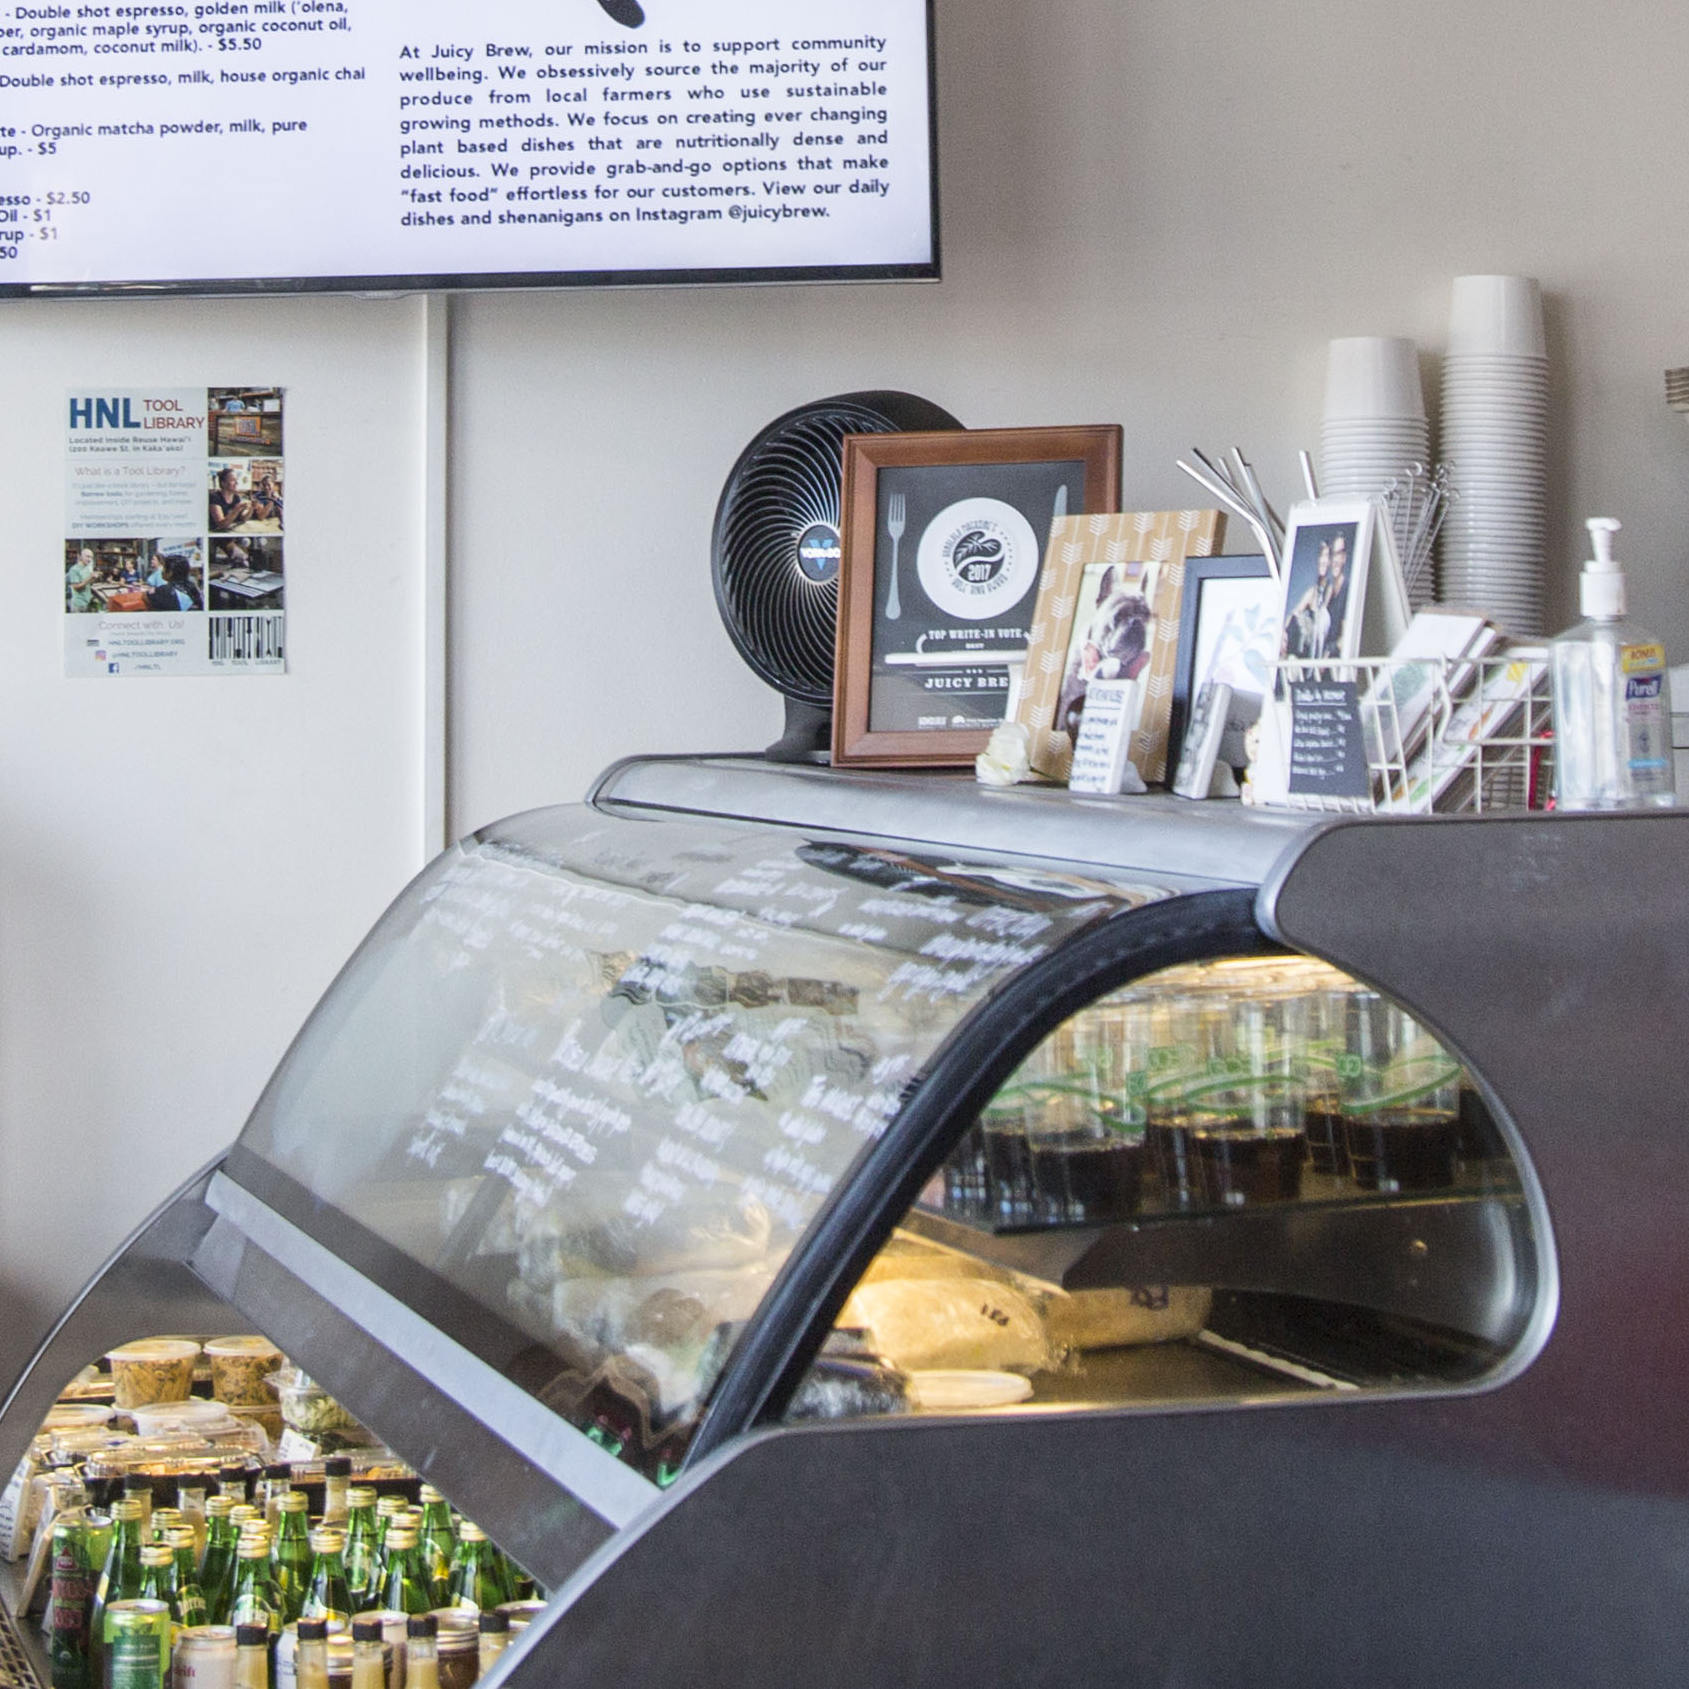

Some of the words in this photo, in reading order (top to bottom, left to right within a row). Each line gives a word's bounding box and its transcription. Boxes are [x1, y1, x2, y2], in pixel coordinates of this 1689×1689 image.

[399, 45, 420, 60] At
[430, 44, 474, 62] Juicy
[486, 43, 533, 58] Brew,
[545, 45, 573, 56] our
[584, 40, 648, 55] mission
[659, 39, 672, 53] is
[682, 40, 701, 52] to
[713, 39, 780, 56] support
[791, 35, 886, 53] community
[399, 66, 488, 84] wellbeing.
[498, 65, 526, 80] We
[536, 62, 635, 81] obsessively
[645, 65, 701, 76] source
[710, 60, 739, 75] the
[749, 59, 820, 78] majority
[830, 57, 849, 72] of
[858, 61, 887, 72] our
[400, 90, 473, 110] produce
[488, 89, 531, 104] from
[546, 88, 587, 103] local
[602, 86, 672, 101] farmers
[687, 84, 725, 99] who
[740, 88, 770, 98] use
[786, 80, 887, 97] sustainable
[400, 115, 471, 135] growing
[479, 113, 559, 129] methods.
[567, 112, 596, 127] We
[603, 111, 649, 126] focus
[657, 114, 678, 125] on
[686, 108, 756, 127] creating
[764, 111, 803, 123] ever
[810, 106, 887, 125] changing
[400, 139, 444, 159] plant
[457, 137, 508, 154] based
[521, 137, 575, 152] dishes
[588, 135, 622, 151] that
[636, 139, 663, 150] are
[676, 132, 780, 151] nutritionally
[792, 131, 844, 146] dense
[857, 129, 888, 145] and
[69, 397, 141, 429] HNL
[144, 399, 183, 412] TOOL
[144, 416, 205, 429] LIBRARY
[968, 563, 991, 581] 2017
[928, 630, 948, 640] TOP
[997, 629, 1023, 639] VOTE
[924, 678, 973, 689] JUICY
[977, 677, 1009, 688] BRE
